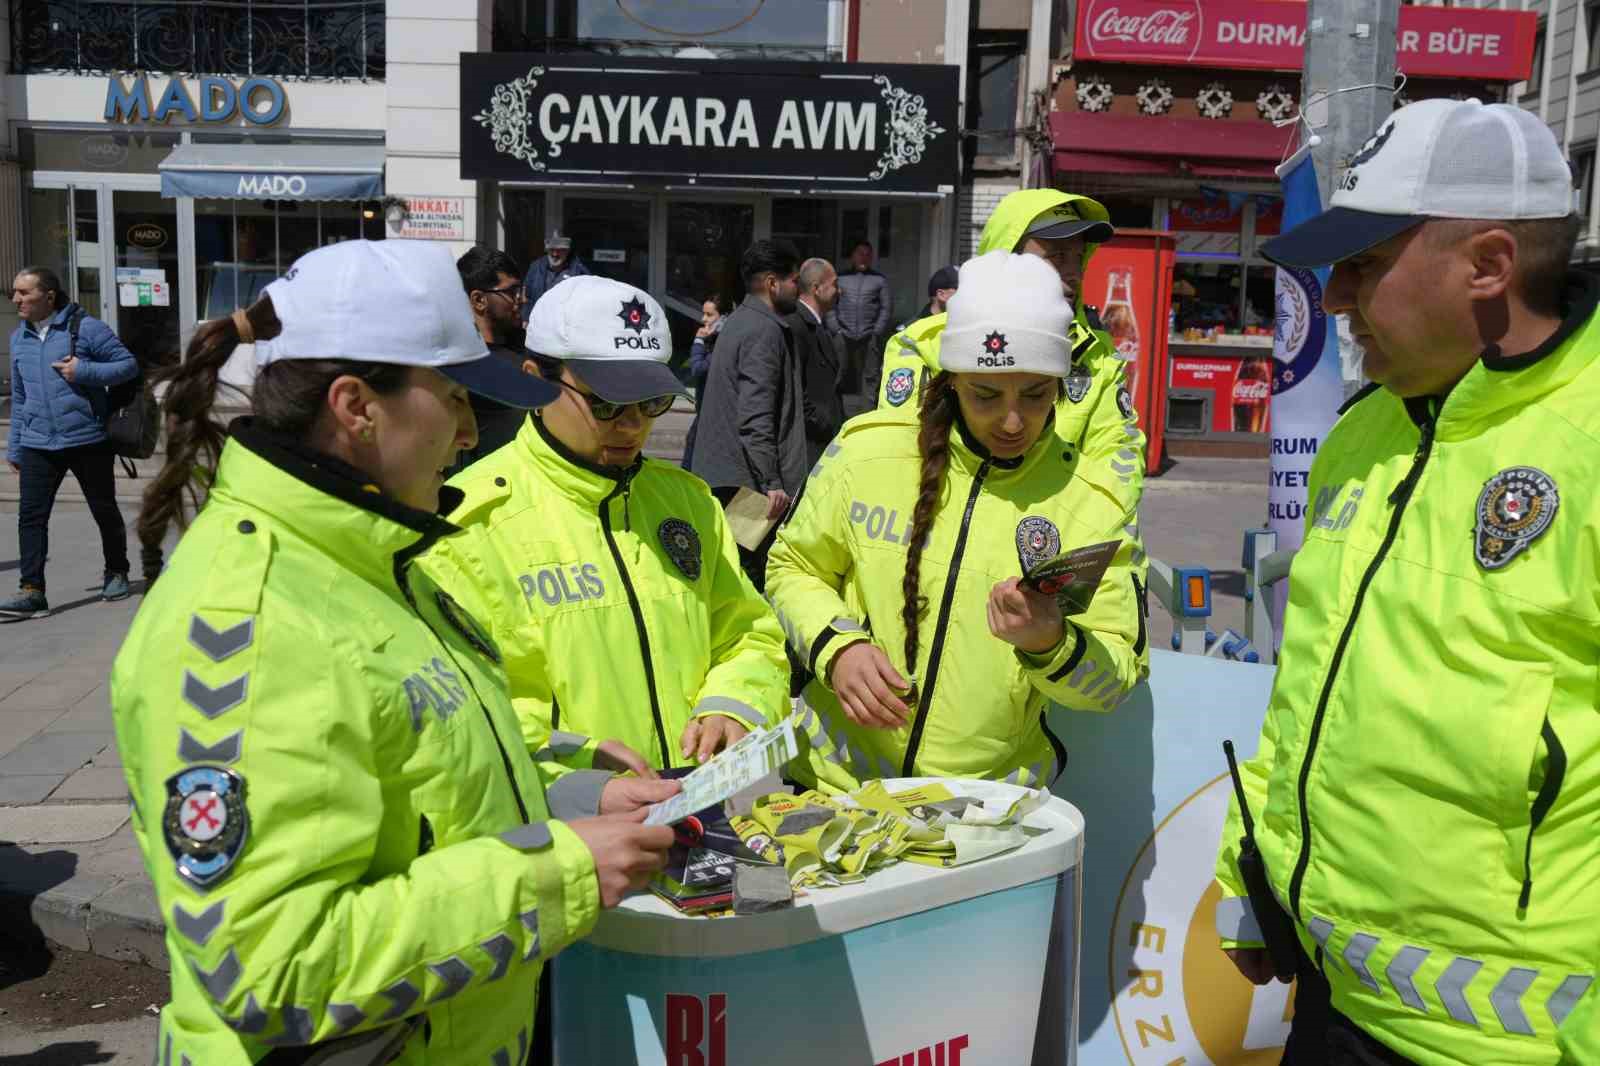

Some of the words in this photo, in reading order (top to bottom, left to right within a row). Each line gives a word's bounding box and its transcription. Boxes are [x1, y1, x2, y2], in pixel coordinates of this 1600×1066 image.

[1427, 27, 1500, 56] BÜFE
[104, 72, 285, 125] MADO
[539, 92, 760, 157] ÇAYKARA
[771, 101, 877, 151] AVM
[238, 175, 306, 196] MADO
[134, 229, 161, 241] MADO
[1271, 438, 1318, 455] RUM
[1128, 920, 1187, 1066] ERZ
